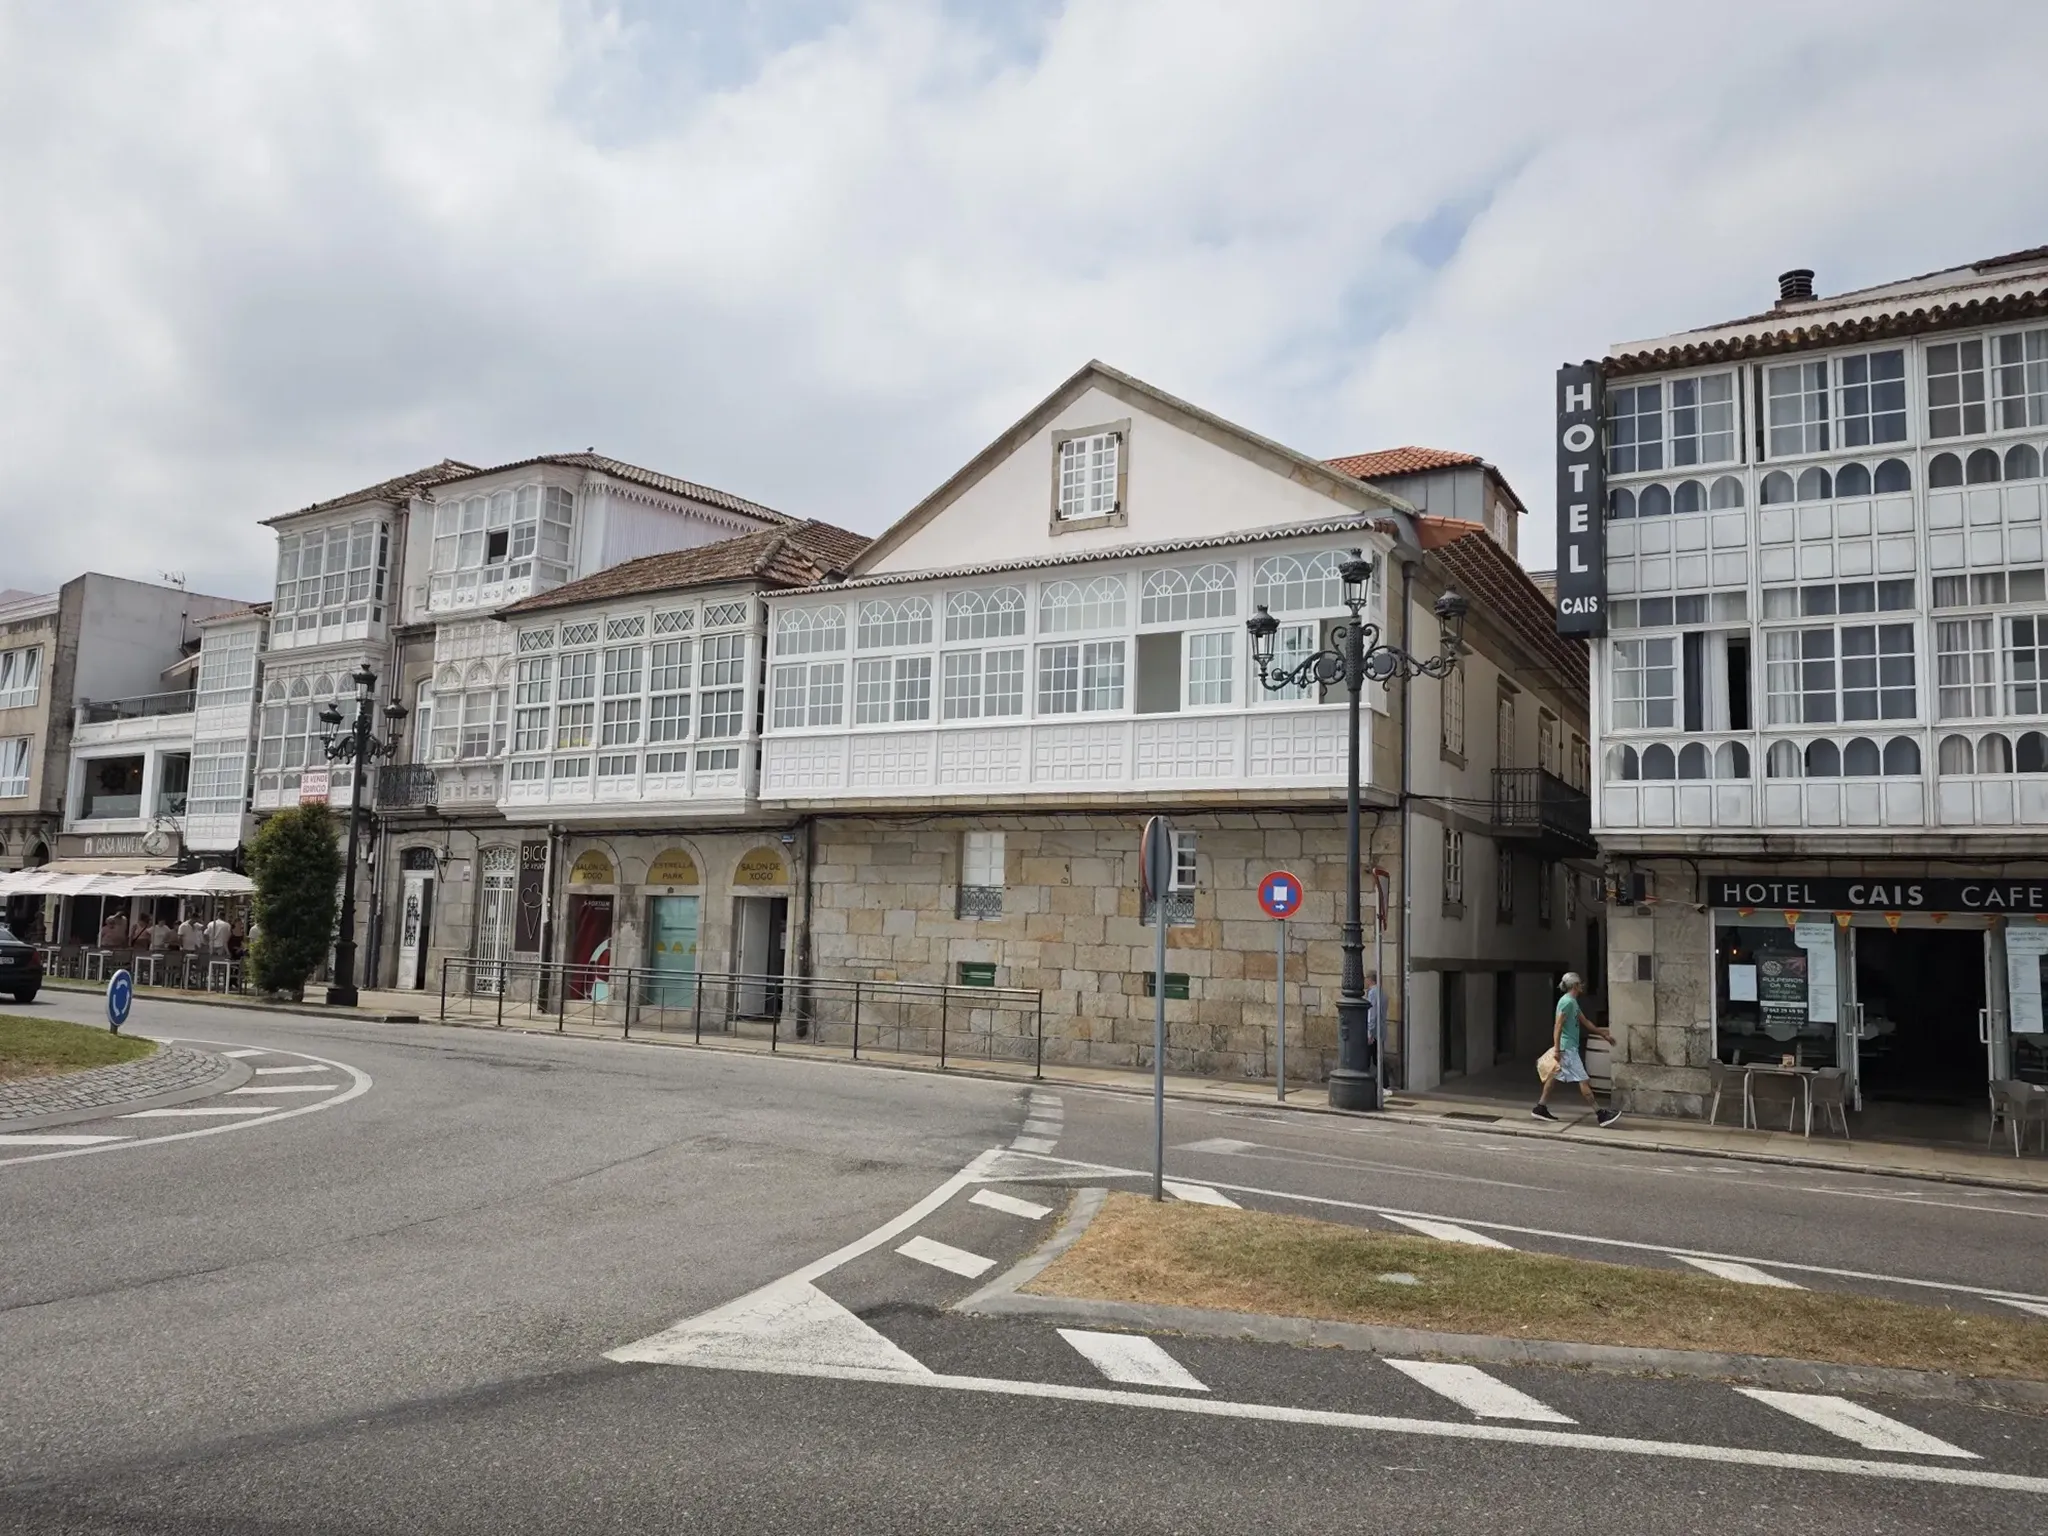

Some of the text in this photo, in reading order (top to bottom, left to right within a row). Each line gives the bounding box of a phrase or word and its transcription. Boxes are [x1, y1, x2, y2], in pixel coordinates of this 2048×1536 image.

[1562, 382, 1596, 575] HOTEL
[1560, 595, 1598, 615] CAIS
[303, 774, 328, 783] SE VENDE
[96, 837, 116, 854] CASA
[576, 863, 609, 872] SALON DE
[653, 861, 694, 869] ESTRELLA
[741, 862, 781, 871] SALON DE
[582, 872, 603, 880] XOGO
[749, 872, 774, 880] XOGO
[1723, 883, 2043, 907] HOTEL CAIS CAFE
